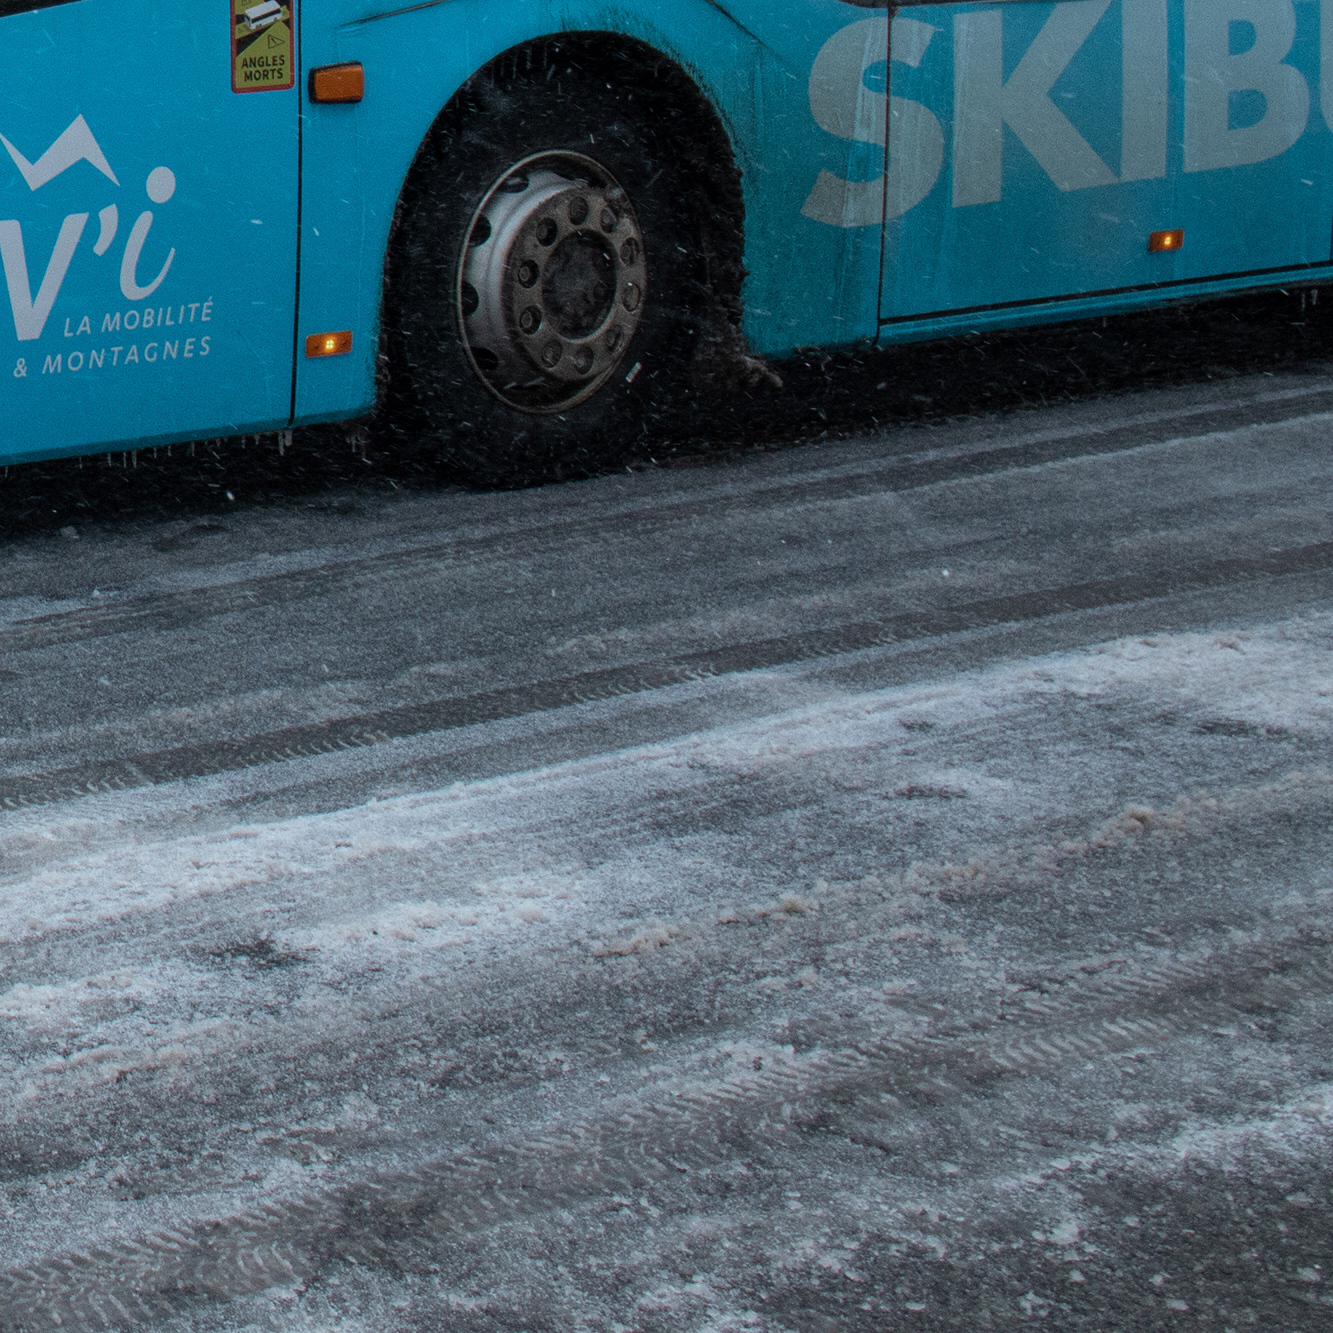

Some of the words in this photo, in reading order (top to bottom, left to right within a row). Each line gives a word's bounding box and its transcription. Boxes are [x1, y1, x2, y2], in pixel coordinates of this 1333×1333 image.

[241, 55, 285, 69] ANGLES
[244, 68, 283, 82] MORTS
[64, 316, 91, 337] LA
[101, 297, 213, 333] MOBILITÉ
[13, 358, 28, 378] &
[42, 336, 212, 374] MONTAGNES
